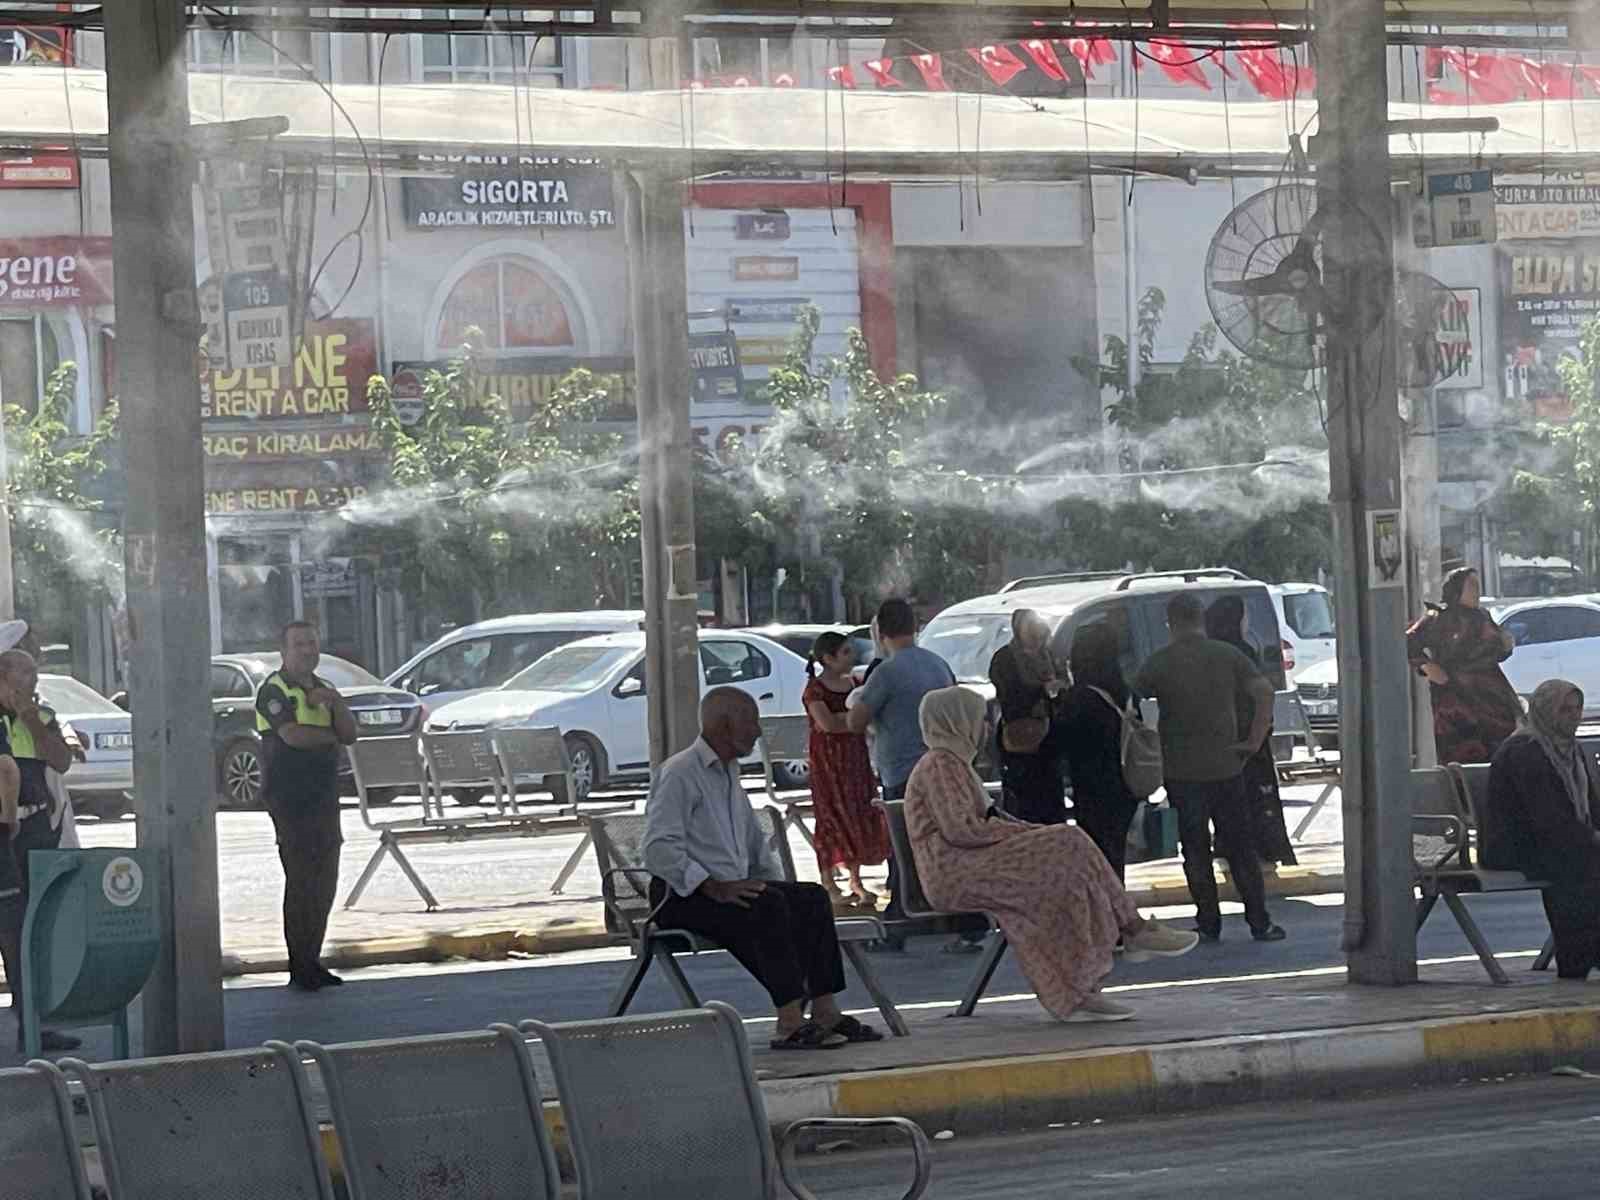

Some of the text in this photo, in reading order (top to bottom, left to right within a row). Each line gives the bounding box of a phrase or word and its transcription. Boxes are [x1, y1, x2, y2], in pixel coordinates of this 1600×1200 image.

[246, 285, 270, 304] 105
[215, 389, 275, 417] RENT
[281, 390, 298, 415] A
[304, 388, 349, 412] CAR
[241, 488, 298, 510] RENT
[303, 488, 321, 506] A
